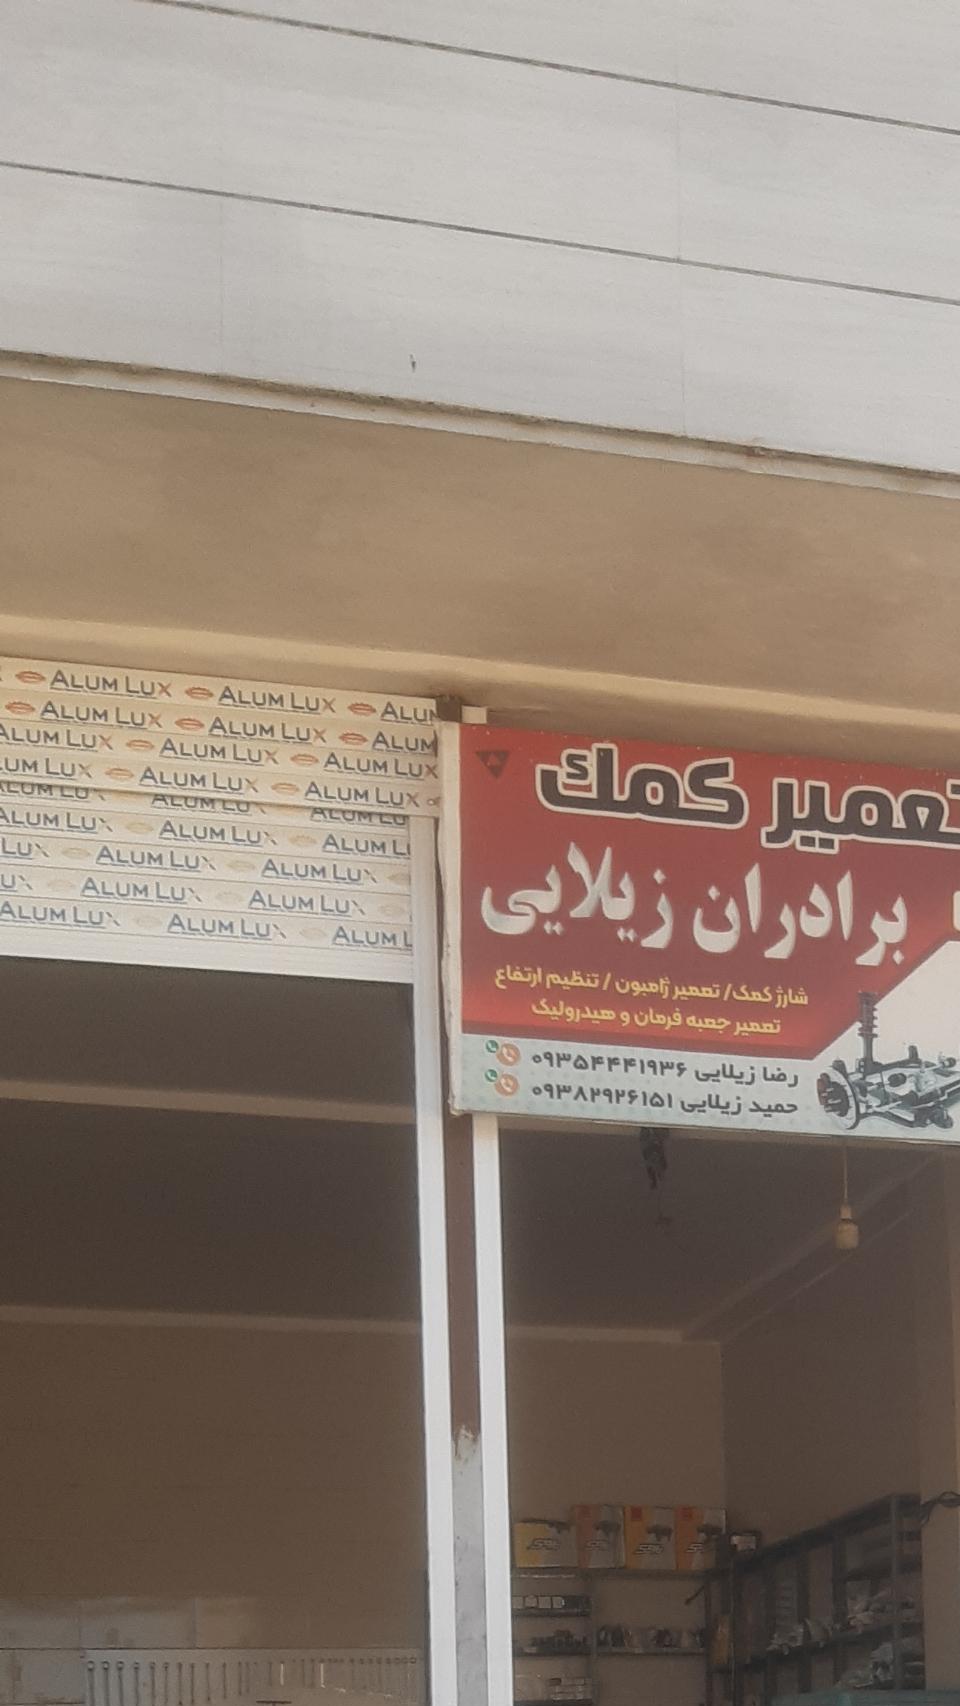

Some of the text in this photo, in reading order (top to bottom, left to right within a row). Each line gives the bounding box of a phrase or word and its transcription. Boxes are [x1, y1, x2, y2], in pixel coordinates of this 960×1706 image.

[51, 670, 172, 697] ALUM LUX
[219, 686, 336, 713] ALUM LUX
[40, 700, 162, 728] ALUM LUX
[67, 729, 113, 750] LUX
[208, 716, 327, 743] ALUM LUX
[160, 738, 279, 765] ALUM LUX
[46, 758, 92, 778] LUX
[324, 752, 438, 779] ALUM LUX
[139, 766, 258, 793] ALUM LUX
[304, 781, 419, 808] ALUM LUX
[159, 820, 225, 840] ALUM
[323, 834, 386, 854] ALUM
[97, 846, 163, 866] ALUM
[261, 859, 326, 879] ALUM
[82, 877, 148, 897] ALUM
[249, 890, 313, 910] ALUM
[480, 842, 908, 967] برادران زیلایی
[167, 914, 234, 934] ALUM
[333, 926, 397, 946] ALUM
[495, 964, 543, 990] ارتفاع
[546, 967, 599, 990] تنظیم
[672, 983, 720, 1001] تعمیر
[775, 987, 809, 1008] شارژ
[531, 999, 782, 1036] تعمیر جعبه فرمان و هیدرولیک
[694, 1063, 755, 1085] زیلایی
[762, 1066, 799, 1088] رضا
[680, 1094, 742, 1116] زیلایی
[748, 1099, 798, 1118] حمید
